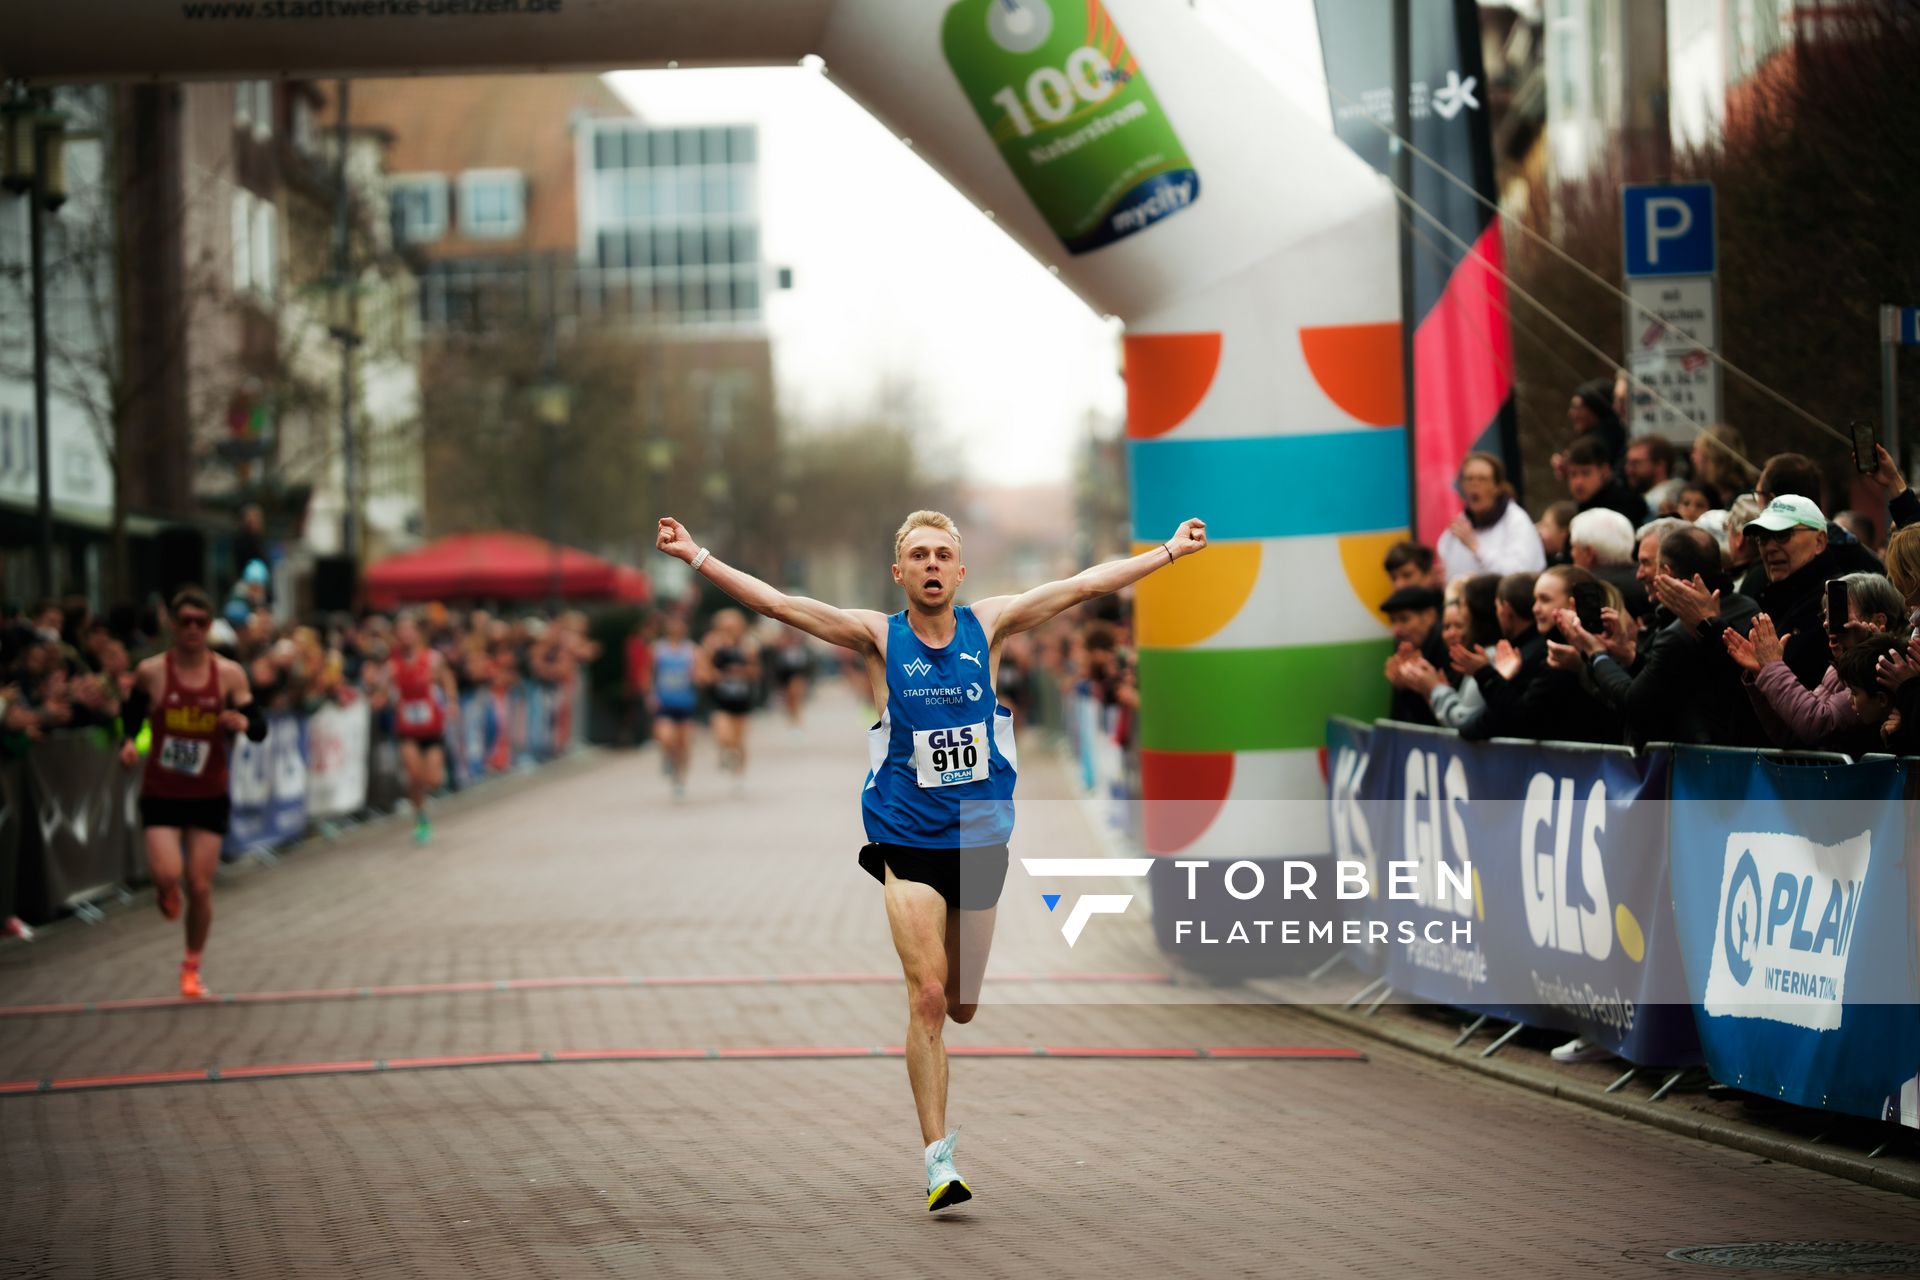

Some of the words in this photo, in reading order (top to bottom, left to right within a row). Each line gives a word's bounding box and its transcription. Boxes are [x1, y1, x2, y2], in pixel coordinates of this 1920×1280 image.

[1029, 99, 1147, 165] Naturstrom
[1111, 177, 1192, 232] mycity
[1645, 197, 1693, 265] P
[903, 687, 962, 697] STADTWERKE
[925, 696, 963, 705] BOCHUM
[932, 745, 977, 772] 910
[1767, 872, 1861, 957] PLAN
[1583, 982, 1634, 1041] People
